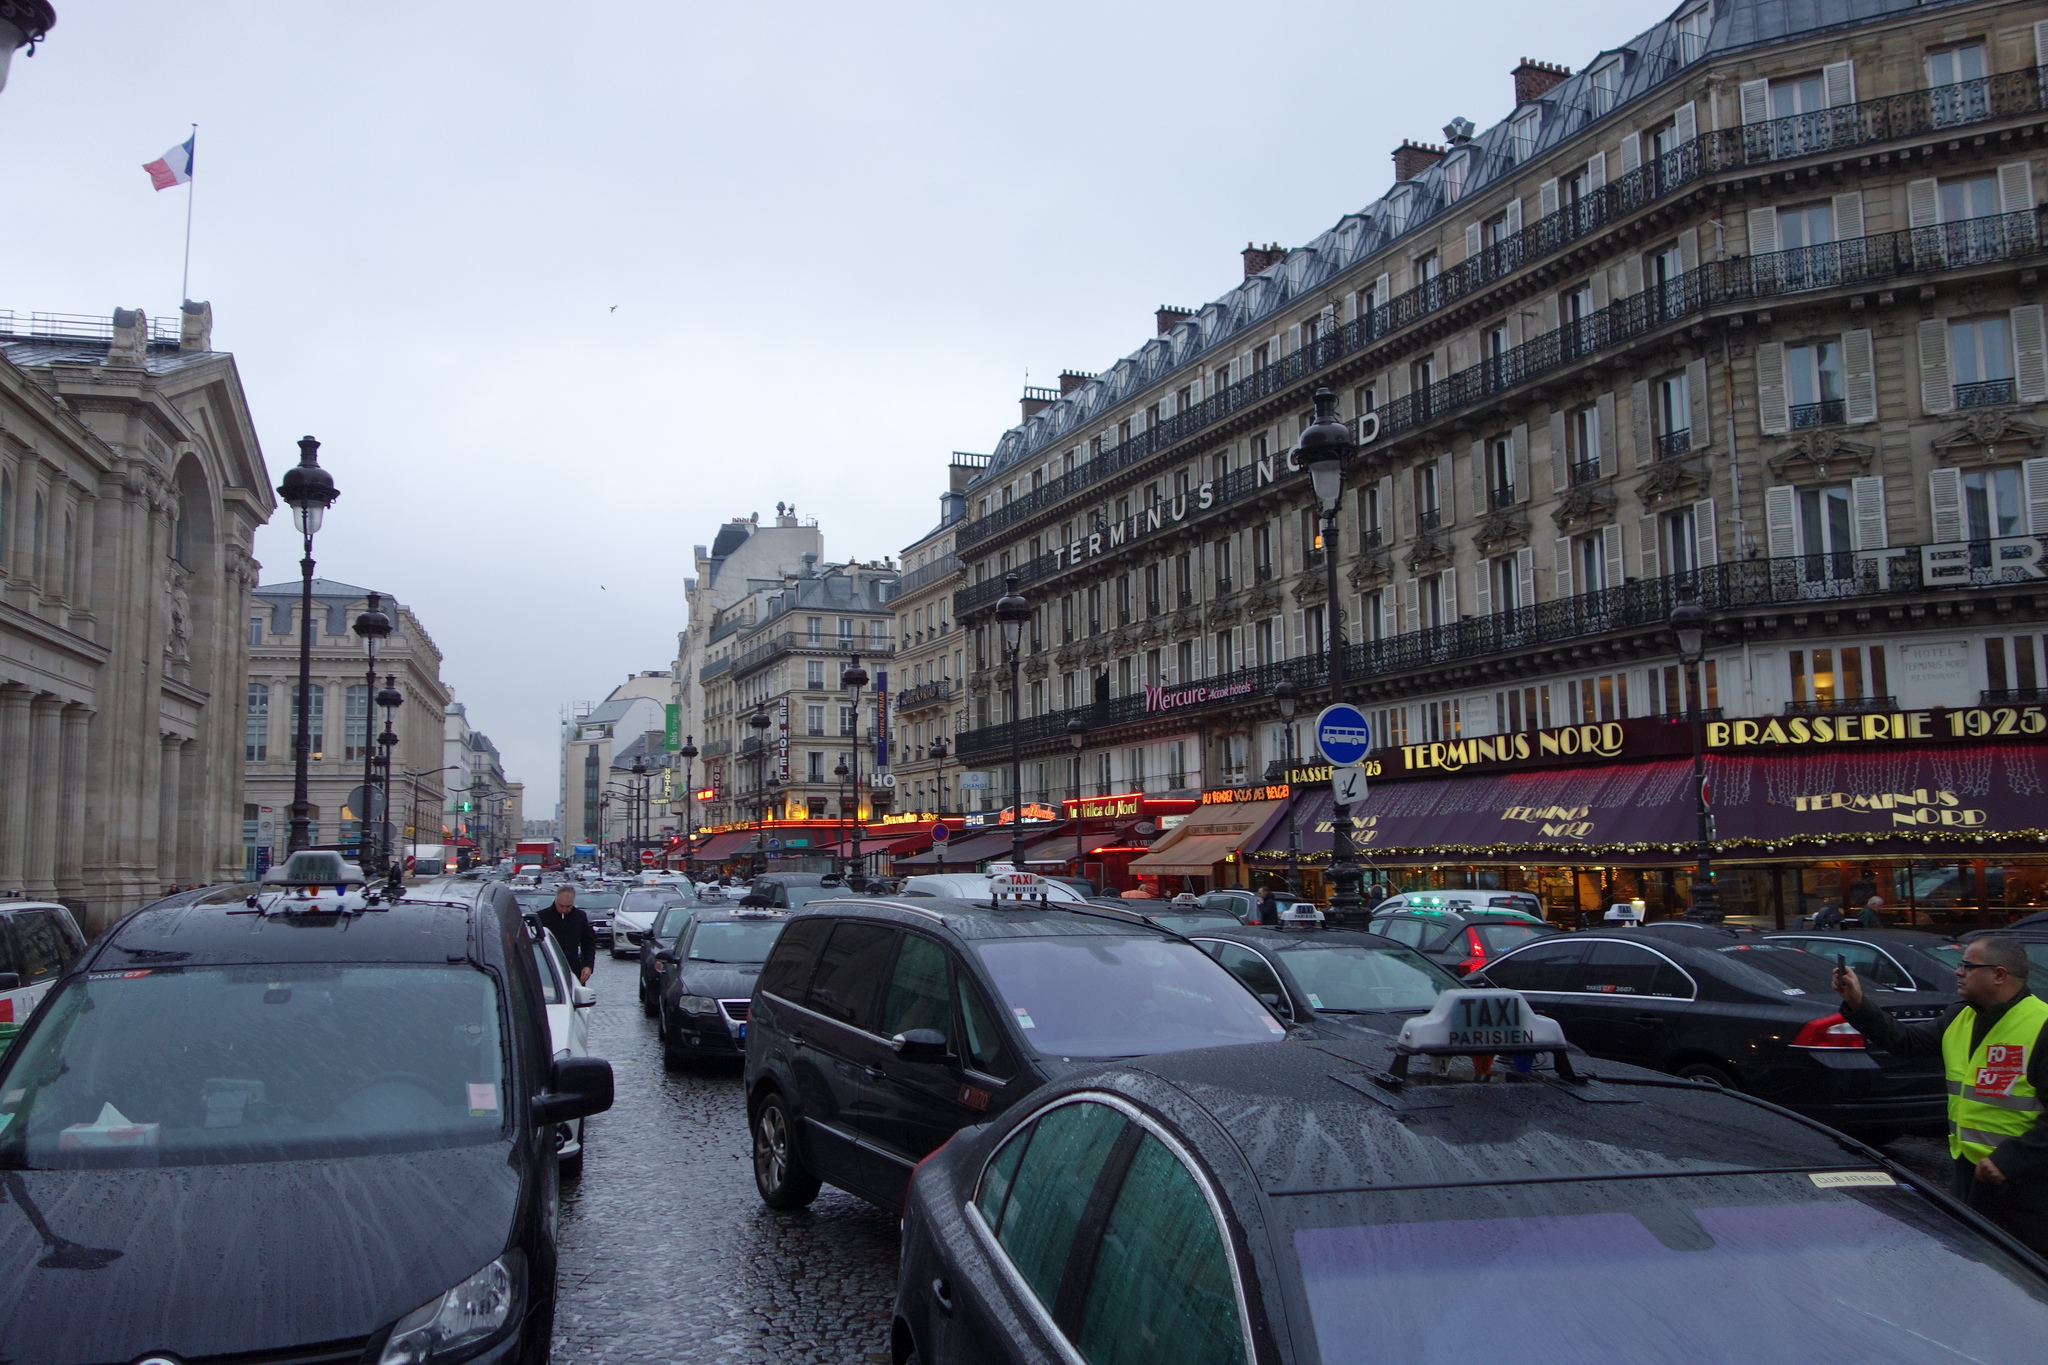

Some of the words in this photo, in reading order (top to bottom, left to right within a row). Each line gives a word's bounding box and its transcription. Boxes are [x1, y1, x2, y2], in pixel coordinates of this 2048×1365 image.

[1054, 482, 1214, 571] TERMINUS
[1257, 411, 1381, 487] NOD
[1857, 536, 2047, 591] TER
[1914, 647, 1954, 658] HOTEL
[1144, 684, 1207, 712] Mercure
[779, 697, 788, 725] NEW
[670, 731, 678, 745] ibis
[1706, 711, 1934, 748] BRASSERIE
[1945, 707, 2047, 738] 1925
[779, 729, 788, 776] HOTEL
[1401, 732, 1531, 772] TERMINUS
[1539, 722, 1624, 758] NORD
[713, 766, 721, 802] HOTEL
[1082, 801, 1102, 818] Villes
[1104, 800, 1115, 816] du
[1115, 797, 1138, 819] Nord
[1793, 788, 1960, 814] TERMINUS
[1500, 804, 1593, 823] TERMINUS
[1892, 807, 1987, 828] NORD
[1538, 822, 1594, 840] NORD
[287, 872, 342, 881] PARISIEN
[1009, 874, 1033, 885] TAXI
[1296, 905, 1314, 914] TAXI
[1617, 905, 1632, 914] TAXI
[1460, 998, 1520, 1028] TAXI
[1450, 1029, 1534, 1046] PARISIEN
[1987, 1046, 2007, 1063] FO
